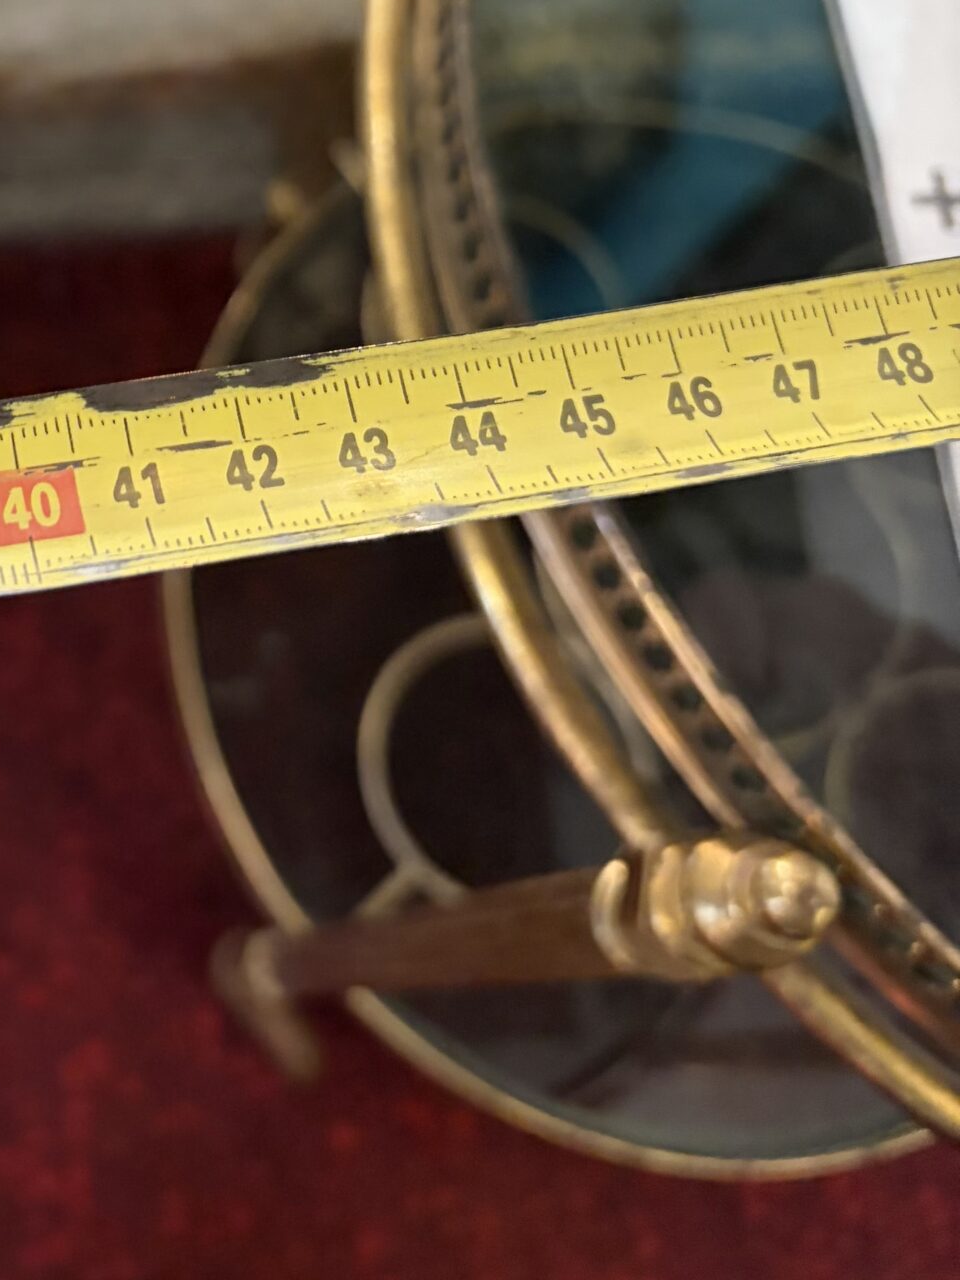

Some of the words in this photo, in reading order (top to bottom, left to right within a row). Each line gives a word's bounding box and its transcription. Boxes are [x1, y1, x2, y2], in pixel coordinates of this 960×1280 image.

[3, 482, 61, 530] 40
[113, 462, 166, 508] 41
[226, 444, 286, 491] 42
[339, 427, 396, 474] 43
[450, 410, 507, 457] 44
[560, 393, 616, 439] 45
[667, 375, 723, 421] 46
[772, 359, 821, 403] 47
[877, 342, 934, 387] 48
